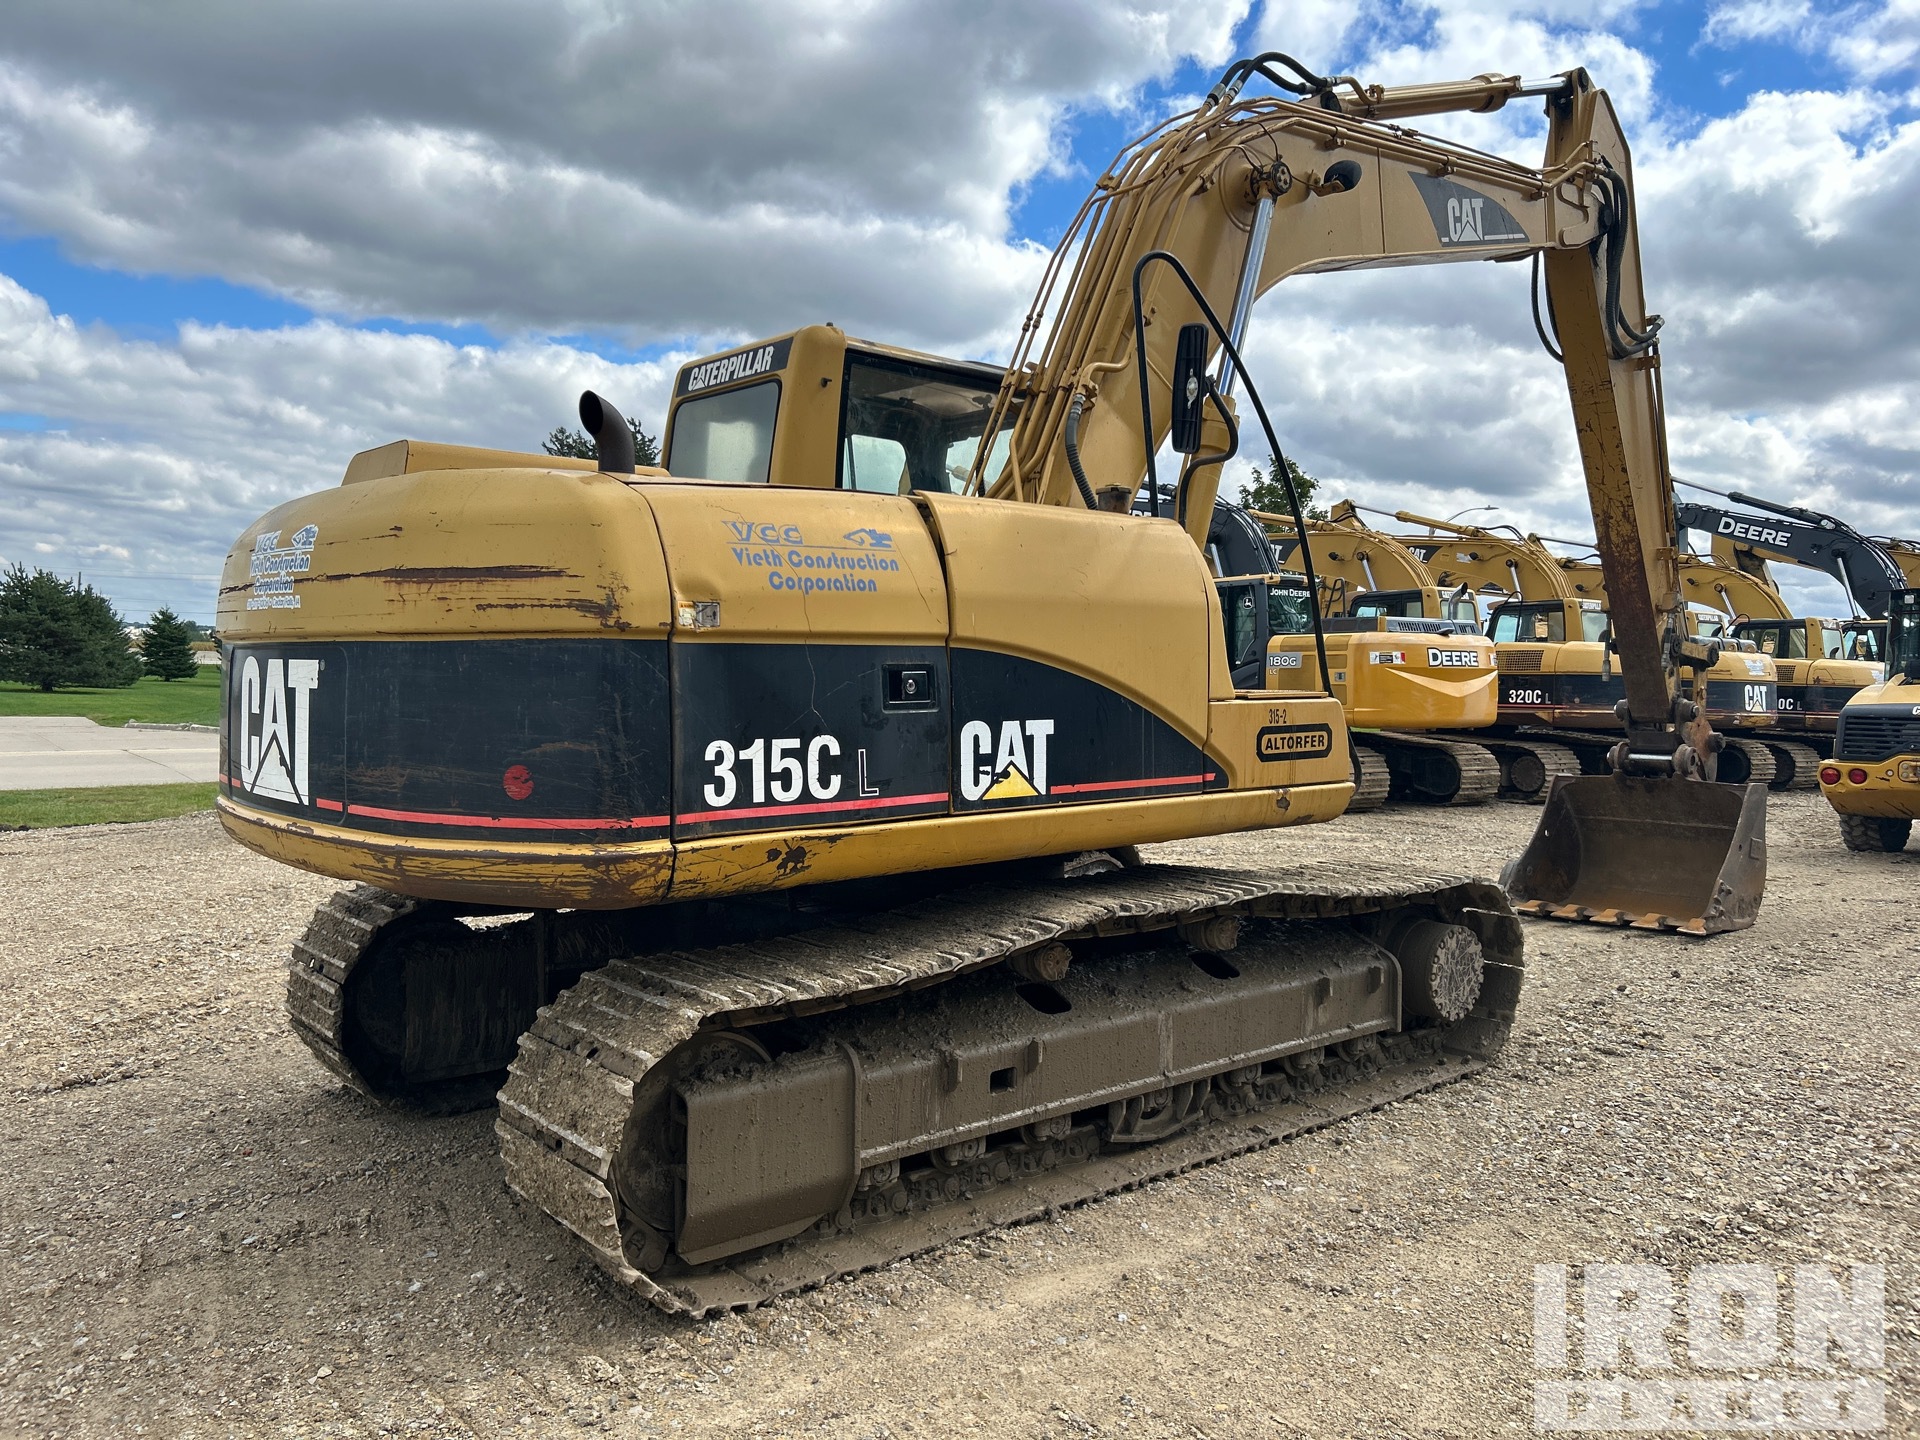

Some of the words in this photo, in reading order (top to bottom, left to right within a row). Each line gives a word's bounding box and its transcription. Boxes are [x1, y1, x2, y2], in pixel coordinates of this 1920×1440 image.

[1447, 197, 1483, 242] CAT
[687, 345, 774, 392] CATERPILLAR
[722, 520, 803, 545] VCC
[1717, 516, 1792, 547] DEERE
[731, 547, 783, 567] Vieth
[787, 550, 900, 572] Construction
[768, 571, 878, 595] Corporation
[1270, 588, 1289, 596] JOHN
[1289, 588, 1311, 598] DEERE
[1269, 656, 1297, 666] 180G
[1427, 647, 1479, 667] DEERE
[1508, 689, 1542, 704] 320C
[1545, 693, 1552, 704] L
[1744, 684, 1767, 712] CAT
[1778, 698, 1794, 710] 0C
[1268, 708, 1288, 724] 315-2
[240, 655, 320, 806] CAT
[1264, 734, 1326, 751] ALTORFER
[703, 734, 842, 808] 315C
[857, 748, 880, 797] L
[960, 718, 1055, 802] CAT
